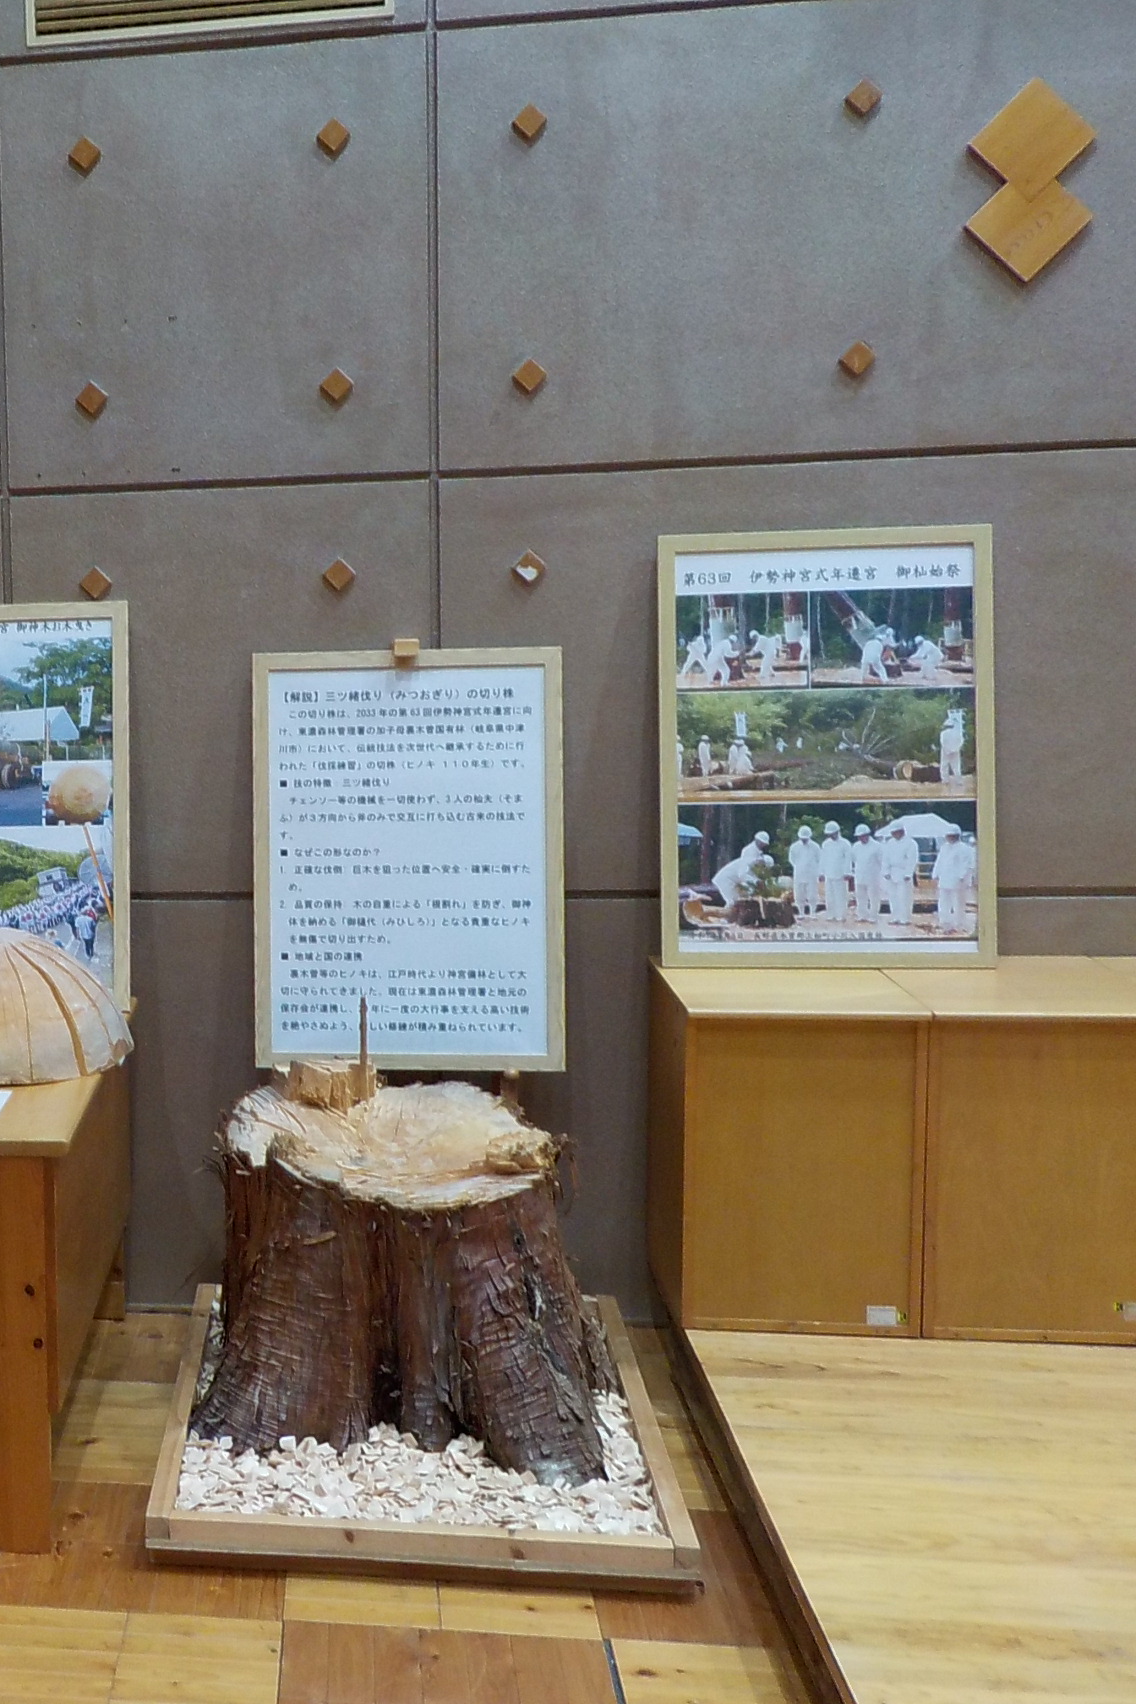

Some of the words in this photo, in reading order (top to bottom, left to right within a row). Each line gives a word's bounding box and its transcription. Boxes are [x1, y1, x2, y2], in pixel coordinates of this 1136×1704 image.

[684, 571, 732, 587] 第63回
[750, 566, 878, 583] 伊勢神宮式年遷宮
[897, 563, 961, 579] 御杣始祭
